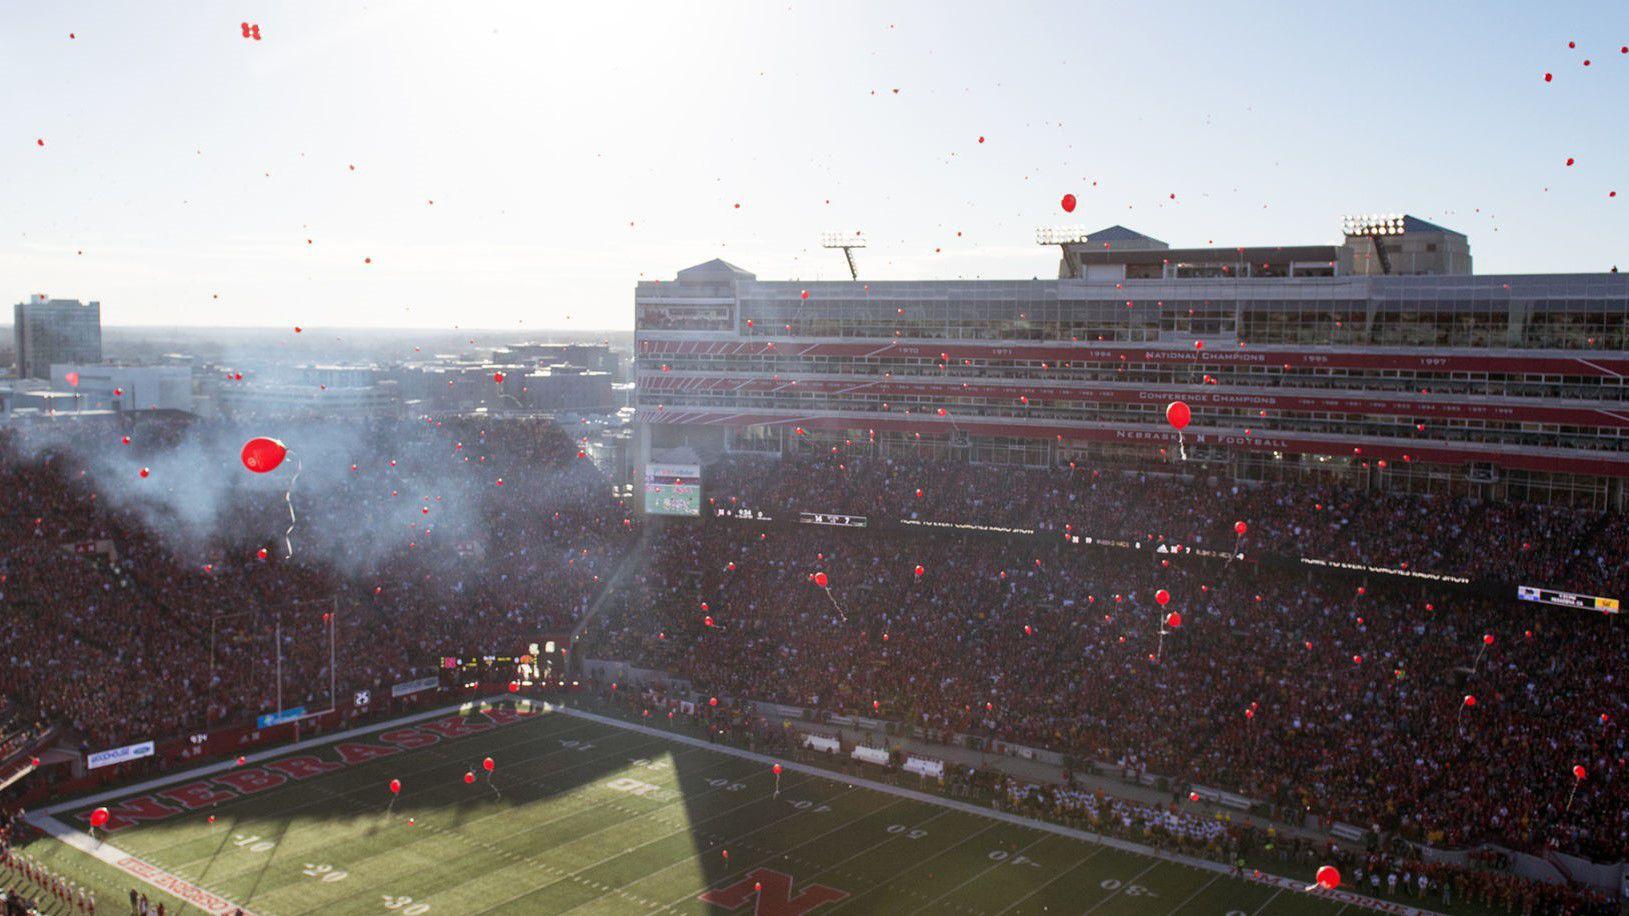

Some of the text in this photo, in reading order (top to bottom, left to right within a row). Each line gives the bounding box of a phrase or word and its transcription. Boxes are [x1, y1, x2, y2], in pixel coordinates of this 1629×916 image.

[1145, 351, 1198, 361] NATIONAL
[1202, 352, 1266, 362] CHAMPIONS
[1139, 391, 1208, 402] CONFERENCE
[1212, 394, 1277, 405] CHAMPIONS
[1217, 435, 1289, 448] FOOTBALL
[76, 703, 542, 833] NEBRASKA
